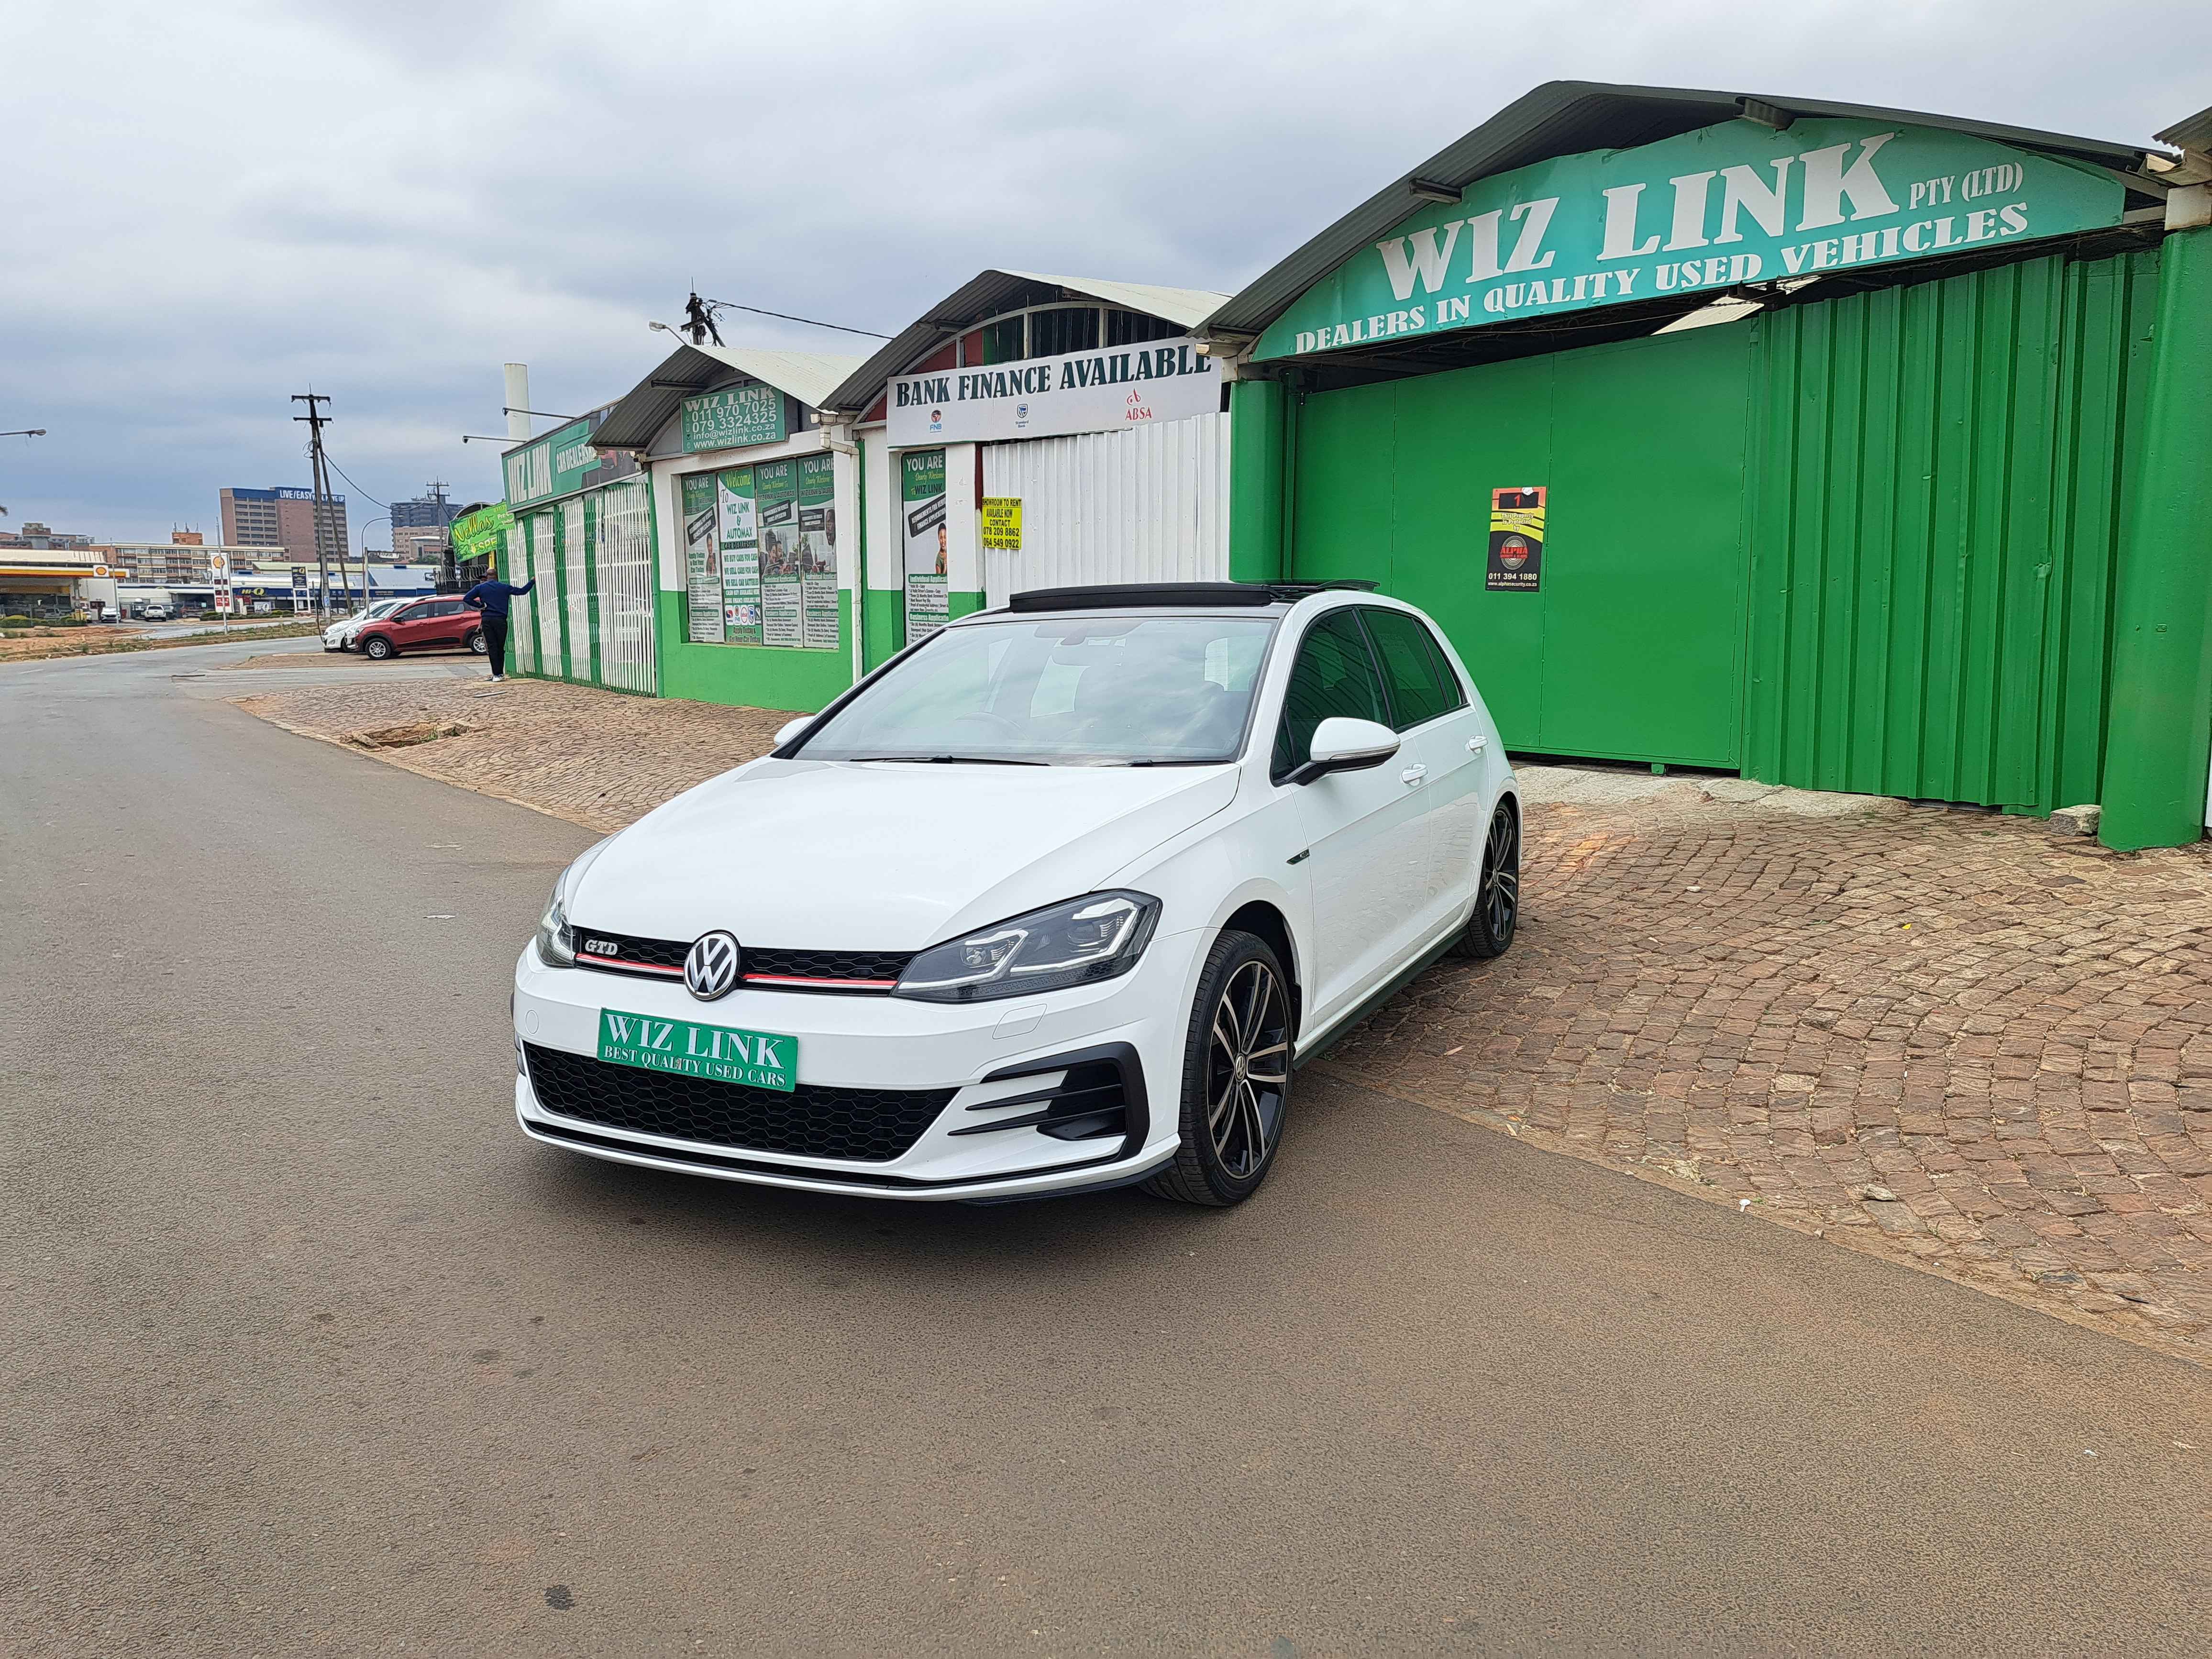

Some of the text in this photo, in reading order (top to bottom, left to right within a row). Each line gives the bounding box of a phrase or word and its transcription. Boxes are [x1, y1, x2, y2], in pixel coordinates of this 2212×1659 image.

[1376, 133, 2024, 301] WIZ LINK PTY (LTD)
[1294, 202, 2027, 354] DEALERS IN QUALITY USED VEHICLES
[896, 345, 1212, 407] BANK FINANCE AVAILABLE
[684, 387, 776, 412] WIZ LINK
[692, 398, 776, 422] 011 970 7025
[1125, 407, 1152, 420] ABSA
[693, 410, 776, 433] 079 3324325
[694, 423, 775, 440] info@wizlink.co.za
[694, 431, 776, 449] www.wizlink.co.za
[804, 460, 819, 474] YOU
[907, 455, 943, 472] YOU ARE
[508, 442, 553, 505] WIZ LINK
[726, 470, 751, 487] Welcome
[760, 464, 788, 480] YOU ARE
[685, 476, 708, 491] YOU ARE
[915, 485, 926, 495] WIZ
[928, 483, 942, 493] LINK
[720, 488, 729, 503] To
[1514, 494, 1521, 507] 1
[726, 501, 750, 515] WIZ LINK
[986, 509, 1003, 518] AVAILABLE
[737, 515, 741, 526] &
[453, 513, 494, 547] Nellas
[726, 527, 752, 540] AUTOMAX
[984, 527, 1019, 536] 078 209 8862
[724, 540, 756, 550] CAR DEALERSHIP
[984, 537, 1019, 548] 064 549 0922
[585, 940, 618, 955] GTD
[605, 1013, 785, 1069] WIZ LINK
[604, 1045, 785, 1087] BEST QUALITY USED CARS
